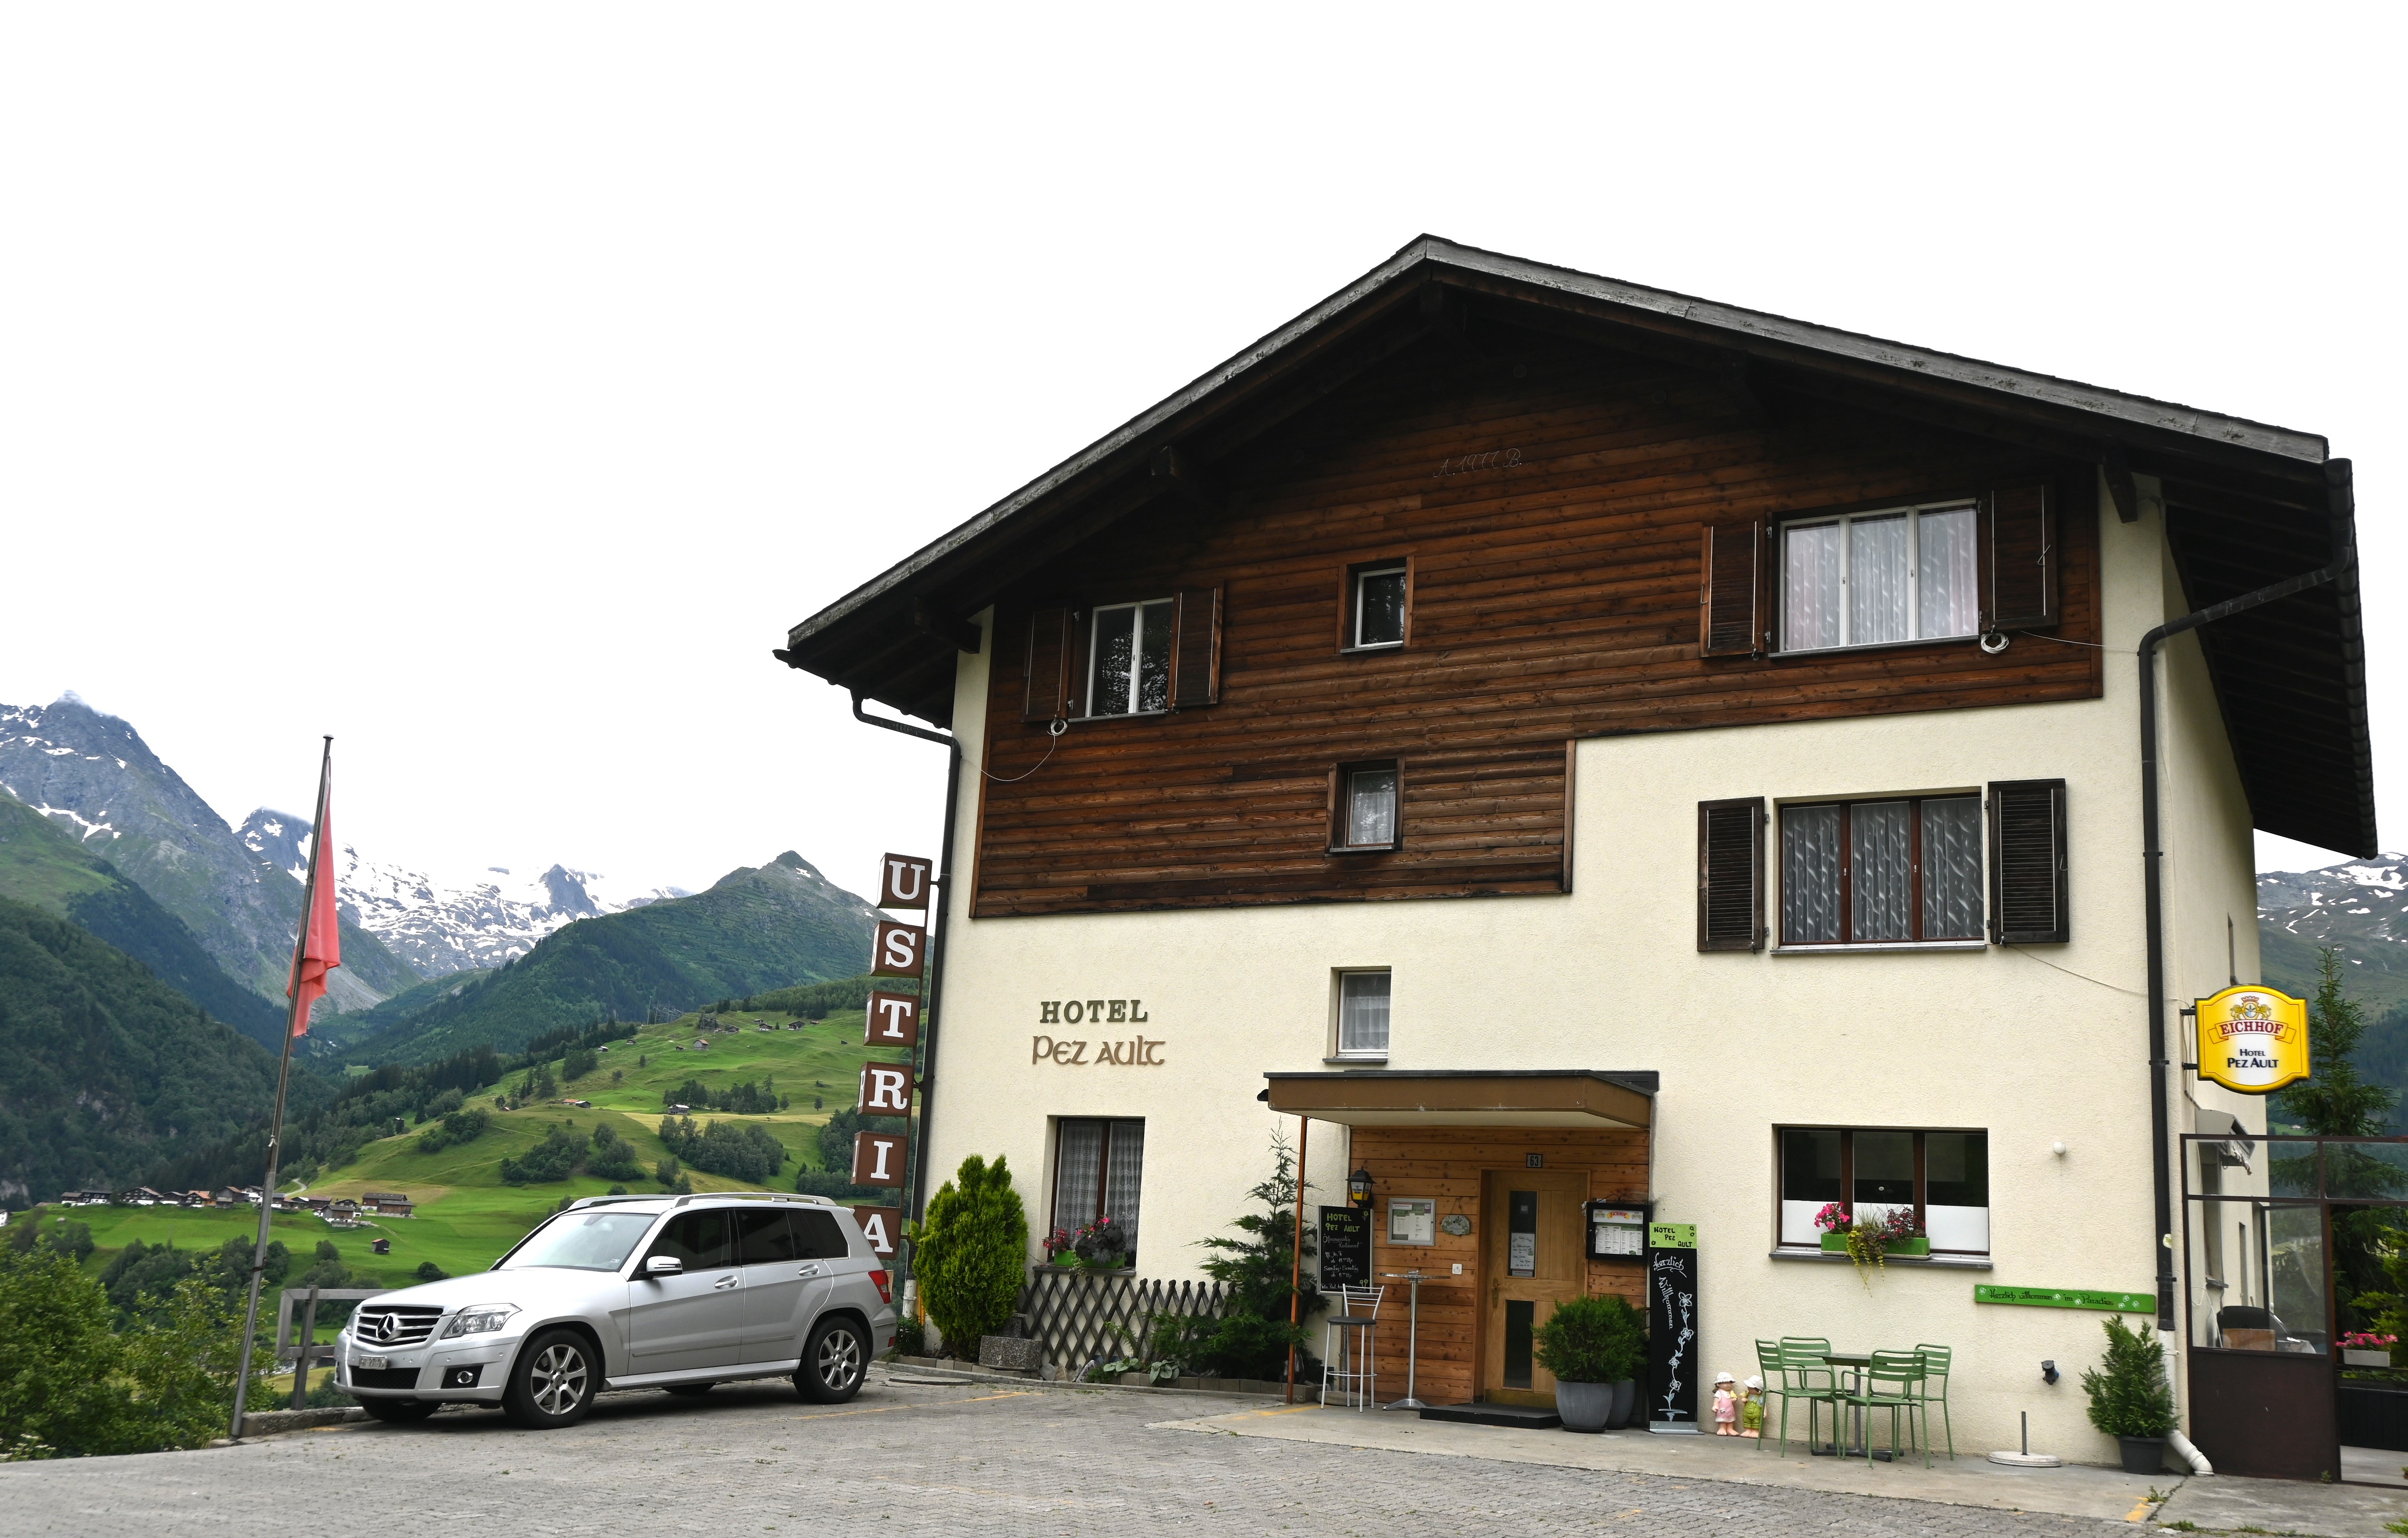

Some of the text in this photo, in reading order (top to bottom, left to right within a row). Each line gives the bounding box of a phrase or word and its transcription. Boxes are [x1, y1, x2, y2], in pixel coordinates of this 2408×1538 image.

[1455, 450, 1500, 474] 1977
[1040, 999, 1148, 1023] HOTEL
[2219, 1021, 2284, 1035] EICHHOF
[864, 860, 925, 1253] USTRIA
[1530, 1156, 1538, 1166] 63
[1327, 1213, 1352, 1221] HOTEL
[1653, 1252, 1684, 1271] Herzlich
[1989, 1288, 2016, 1302] Herzlich
[2018, 1291, 2052, 1300] willkommen
[2079, 1293, 2114, 1306] Paradies
